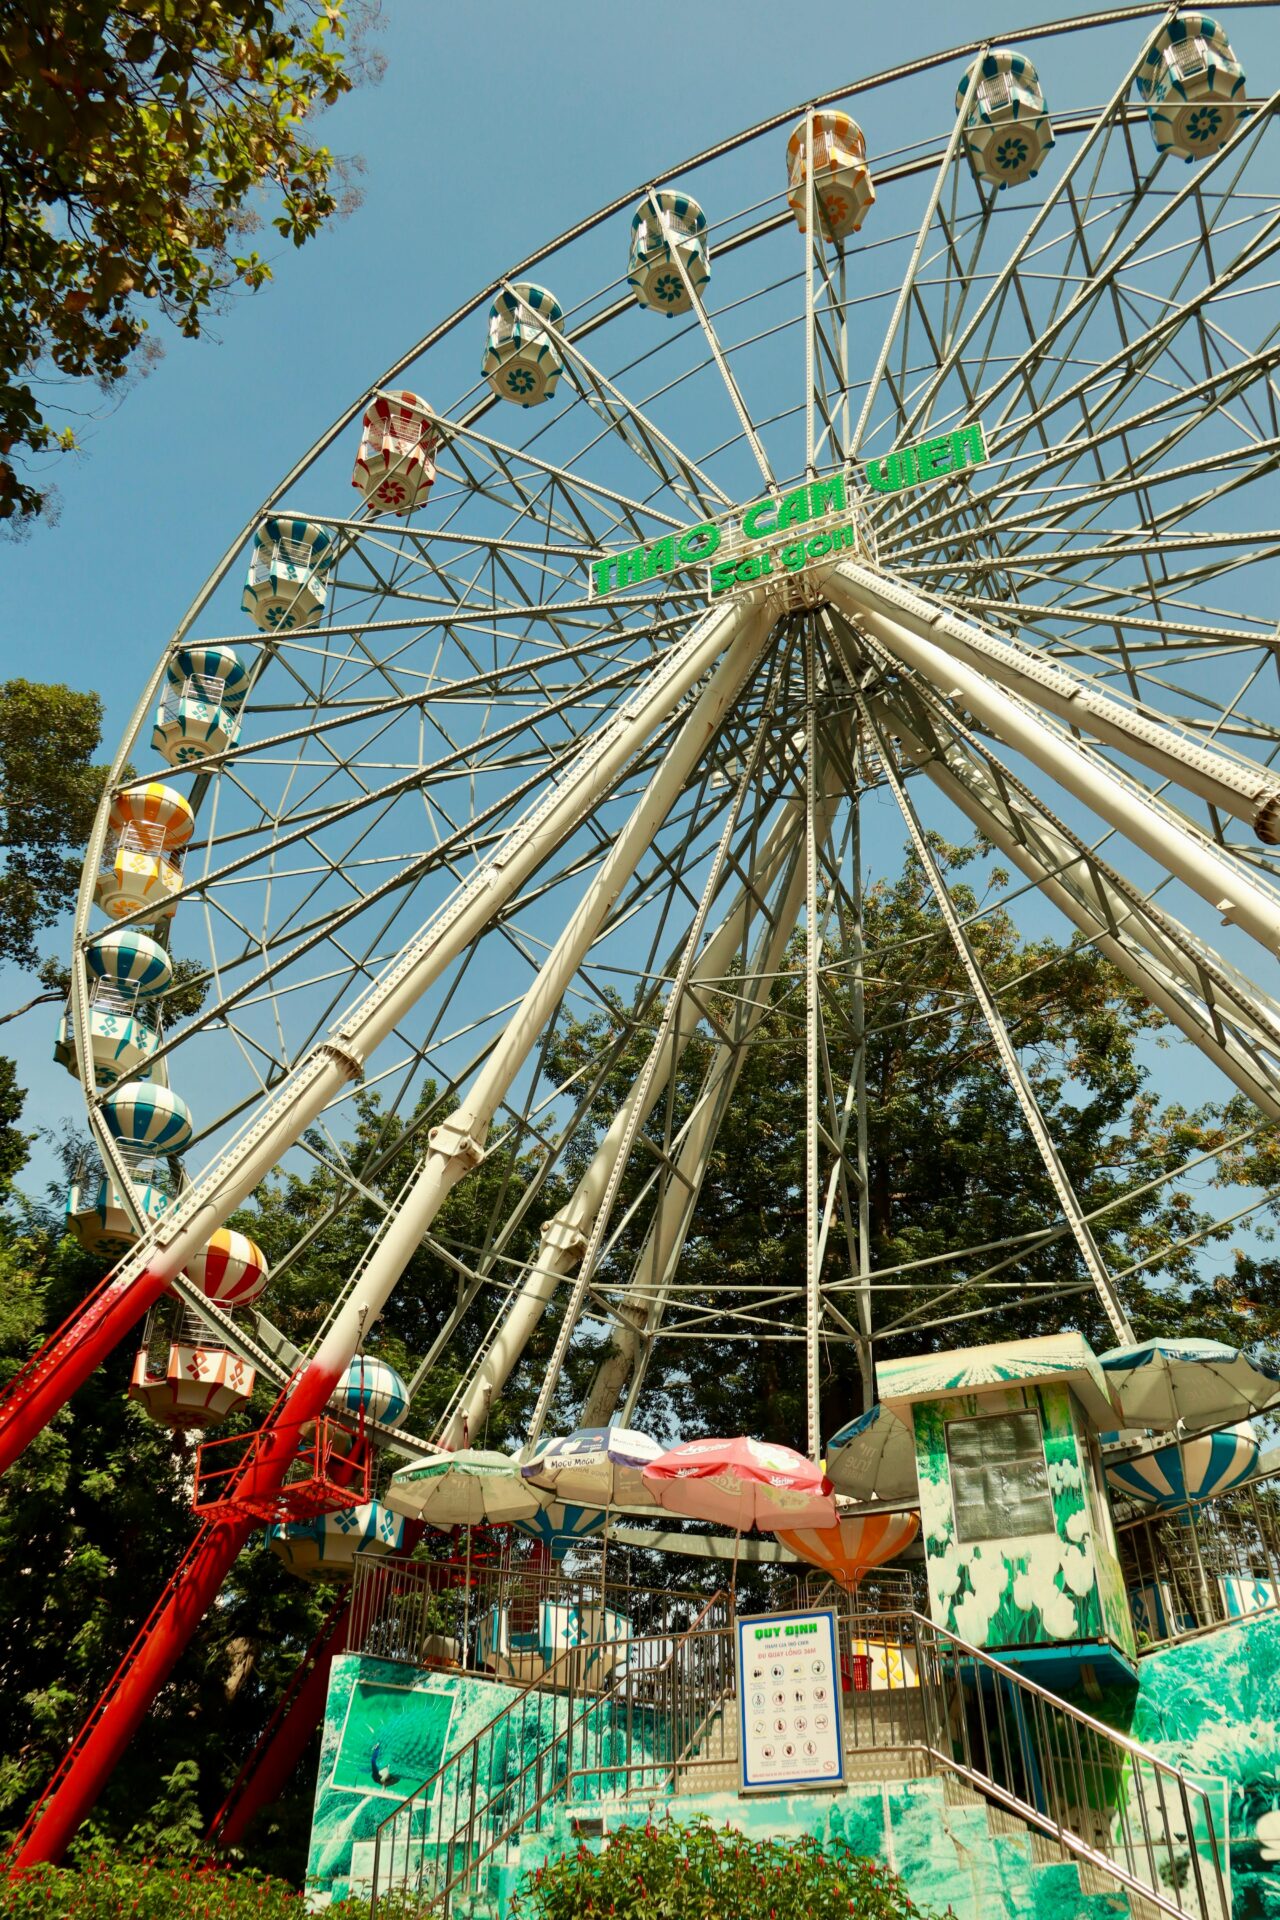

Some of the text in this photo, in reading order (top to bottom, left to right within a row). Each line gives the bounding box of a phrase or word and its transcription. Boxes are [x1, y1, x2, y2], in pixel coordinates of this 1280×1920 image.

[592, 523, 721, 596] THAO
[743, 473, 847, 539] CAM
[755, 1623, 818, 1641] QUY ĐỊNH
